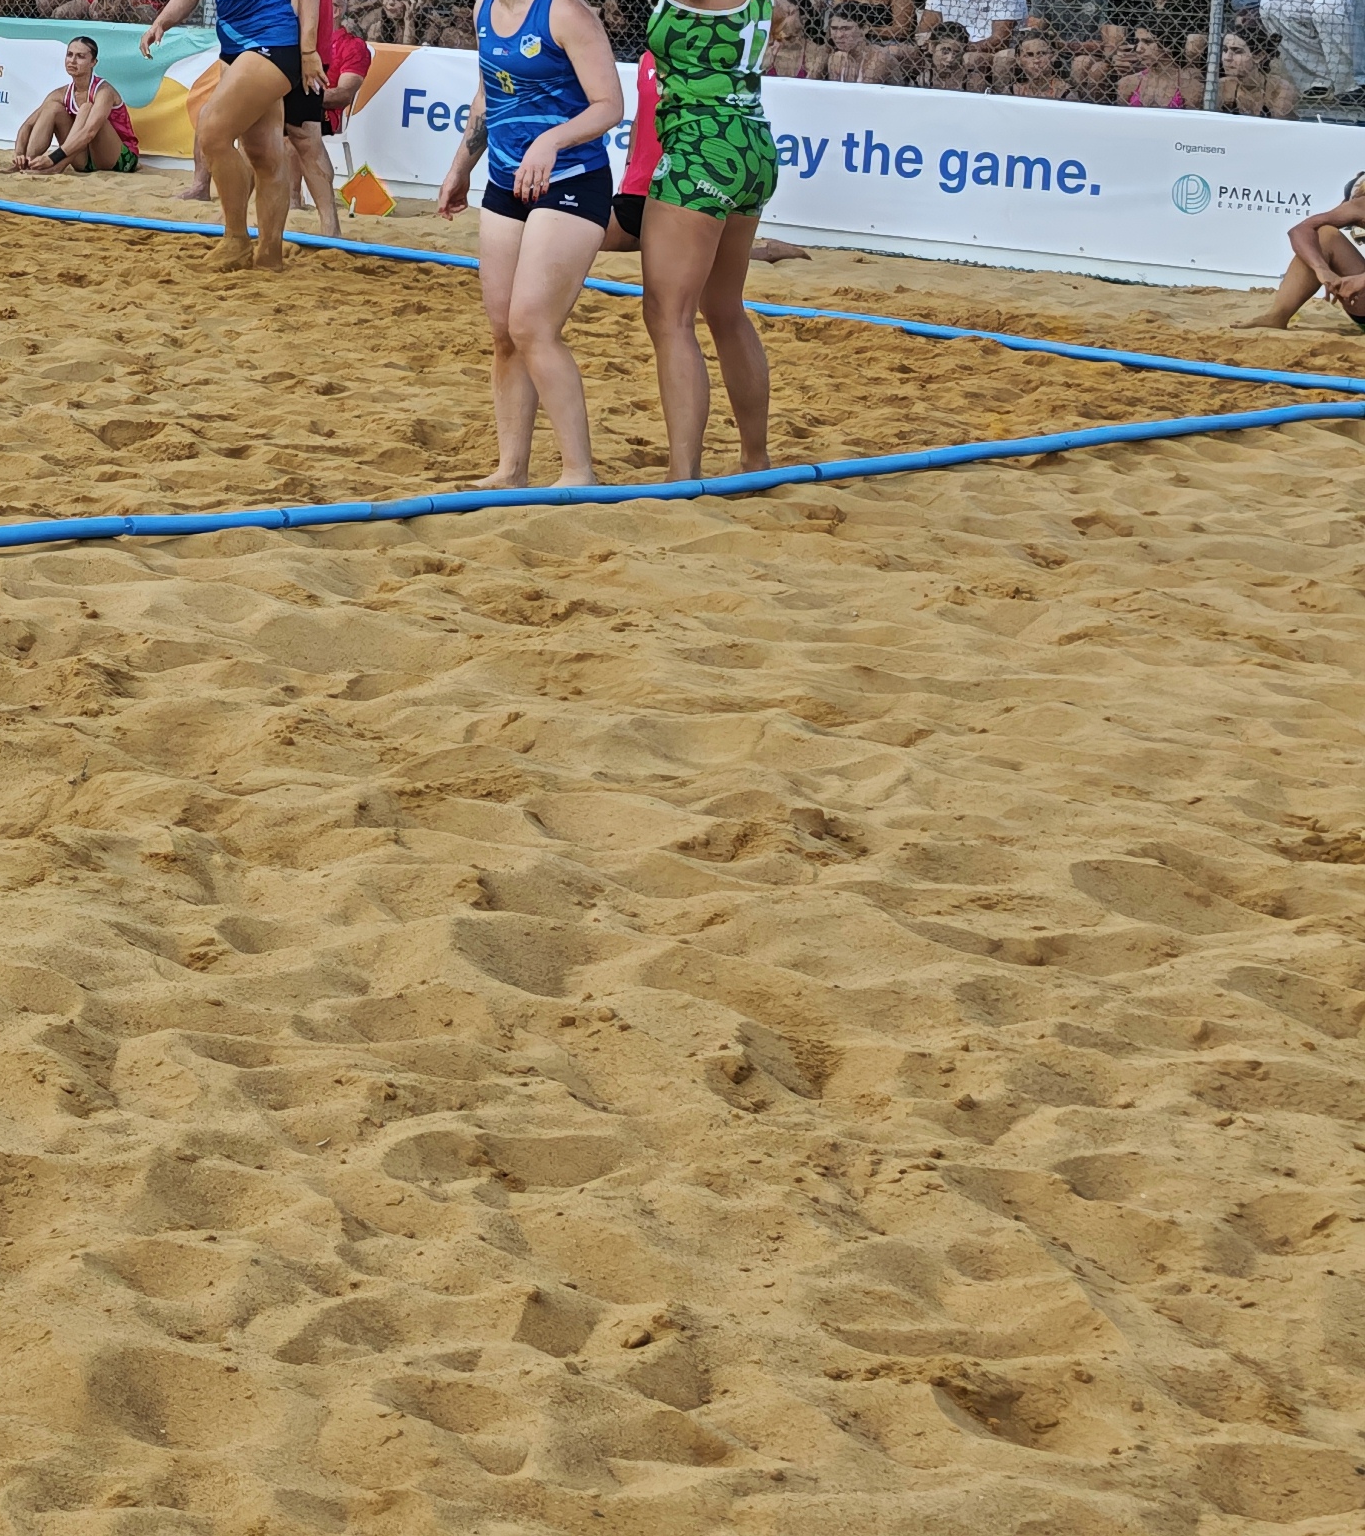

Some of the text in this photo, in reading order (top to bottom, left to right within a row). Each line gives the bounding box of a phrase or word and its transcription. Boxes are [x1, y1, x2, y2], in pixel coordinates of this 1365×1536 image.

[401, 88, 471, 134] Fee
[1174, 142, 1226, 154] Organisers
[842, 130, 923, 178] the
[939, 148, 1101, 196] game.
[1219, 186, 1312, 206] PARALLAX
[1218, 201, 1311, 216] EXPERIENCE
